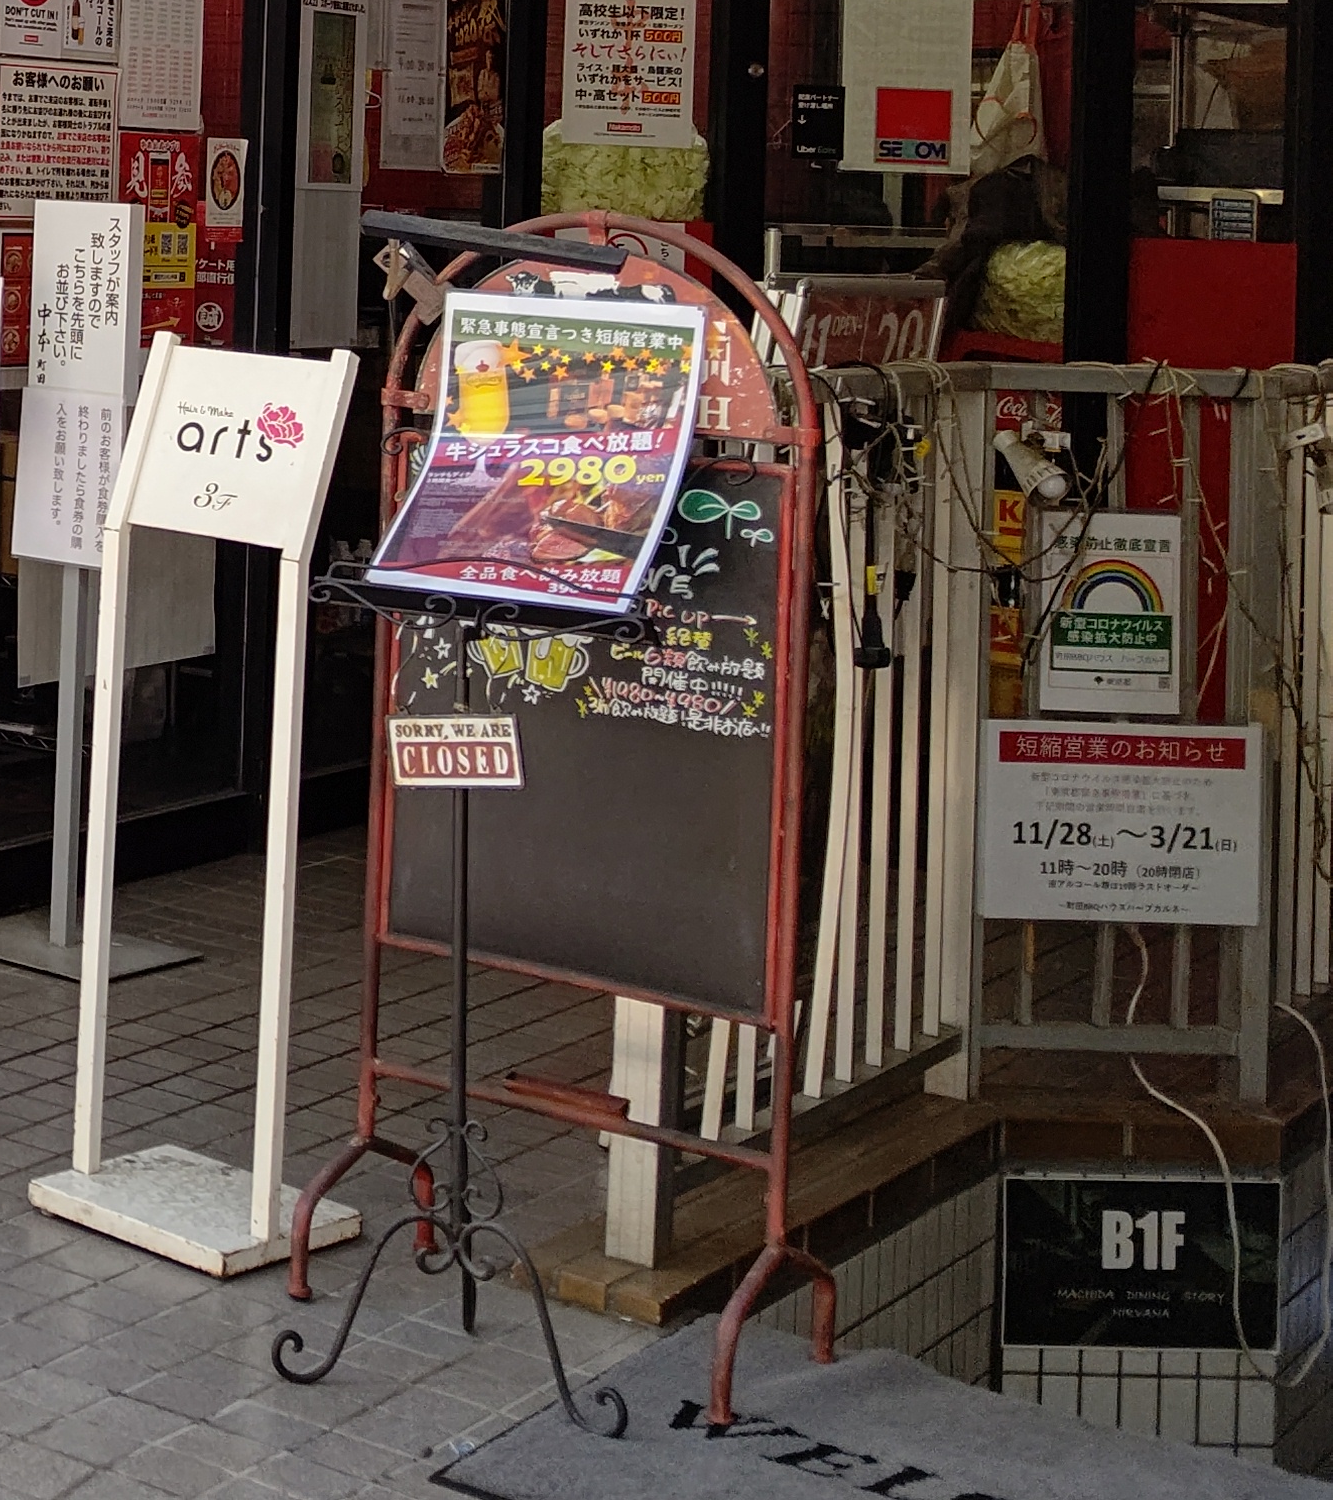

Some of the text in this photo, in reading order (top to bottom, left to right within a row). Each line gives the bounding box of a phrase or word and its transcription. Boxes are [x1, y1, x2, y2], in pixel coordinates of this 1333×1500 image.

[5, 5, 29, 17] DON'T
[30, 8, 46, 19] CUT
[578, 3, 685, 21] 高校生以下限定!
[644, 29, 683, 43] 500円
[12, 70, 105, 92] お客様へのお願い
[576, 73, 683, 88] いずれかをサービス!
[575, 88, 681, 105] 中・高セット 500円
[796, 144, 816, 155] Uber
[88, 232, 105, 329] 致しますので
[104, 217, 122, 326] スタッフが案内
[52, 263, 70, 368] お並び下さい。
[70, 248, 86, 361] こちらを先頭に
[36, 303, 51, 353] 中本
[459, 316, 685, 351] 緊急事態宣言つき短縮営業中
[176, 419, 274, 463] arts
[445, 430, 665, 462] 牛シュラスコ食べ放題!
[51, 402, 68, 527] 入をお願い致します。
[70, 404, 90, 550] 終わりましたら食券の購
[516, 455, 666, 488] 2980 yen
[193, 482, 238, 512] 3F
[645, 598, 676, 619] Pic
[1059, 616, 1164, 632] 新型コロナウイルス
[1067, 629, 1158, 646] 感染拡大防止中
[395, 722, 512, 741] SORRY, WE ARE
[402, 745, 510, 776] CLOSED
[1016, 734, 1227, 763] 短縮営業のお知らせ
[1101, 1209, 1187, 1272] B1F
